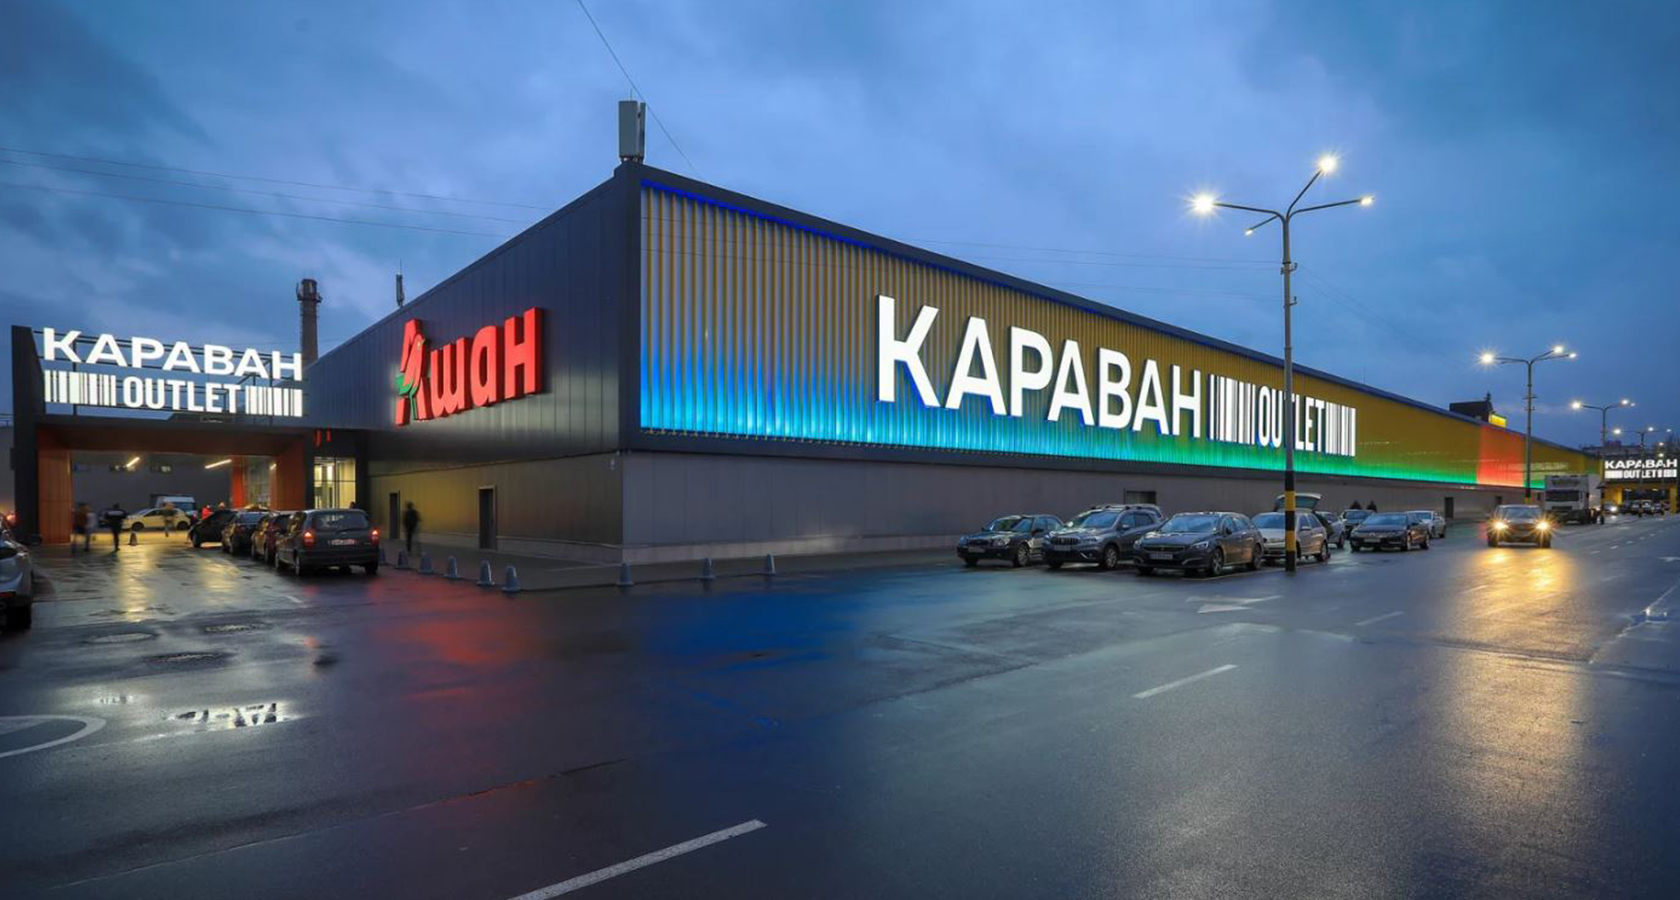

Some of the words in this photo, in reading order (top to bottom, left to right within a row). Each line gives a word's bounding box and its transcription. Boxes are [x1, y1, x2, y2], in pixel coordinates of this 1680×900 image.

[43, 327, 303, 381] КАРАВАН
[876, 294, 1202, 439] КАРАВАН
[1258, 385, 1325, 453] OULET
[122, 375, 242, 414] OUTLET
[1604, 458, 1678, 469] КАРАВАН
